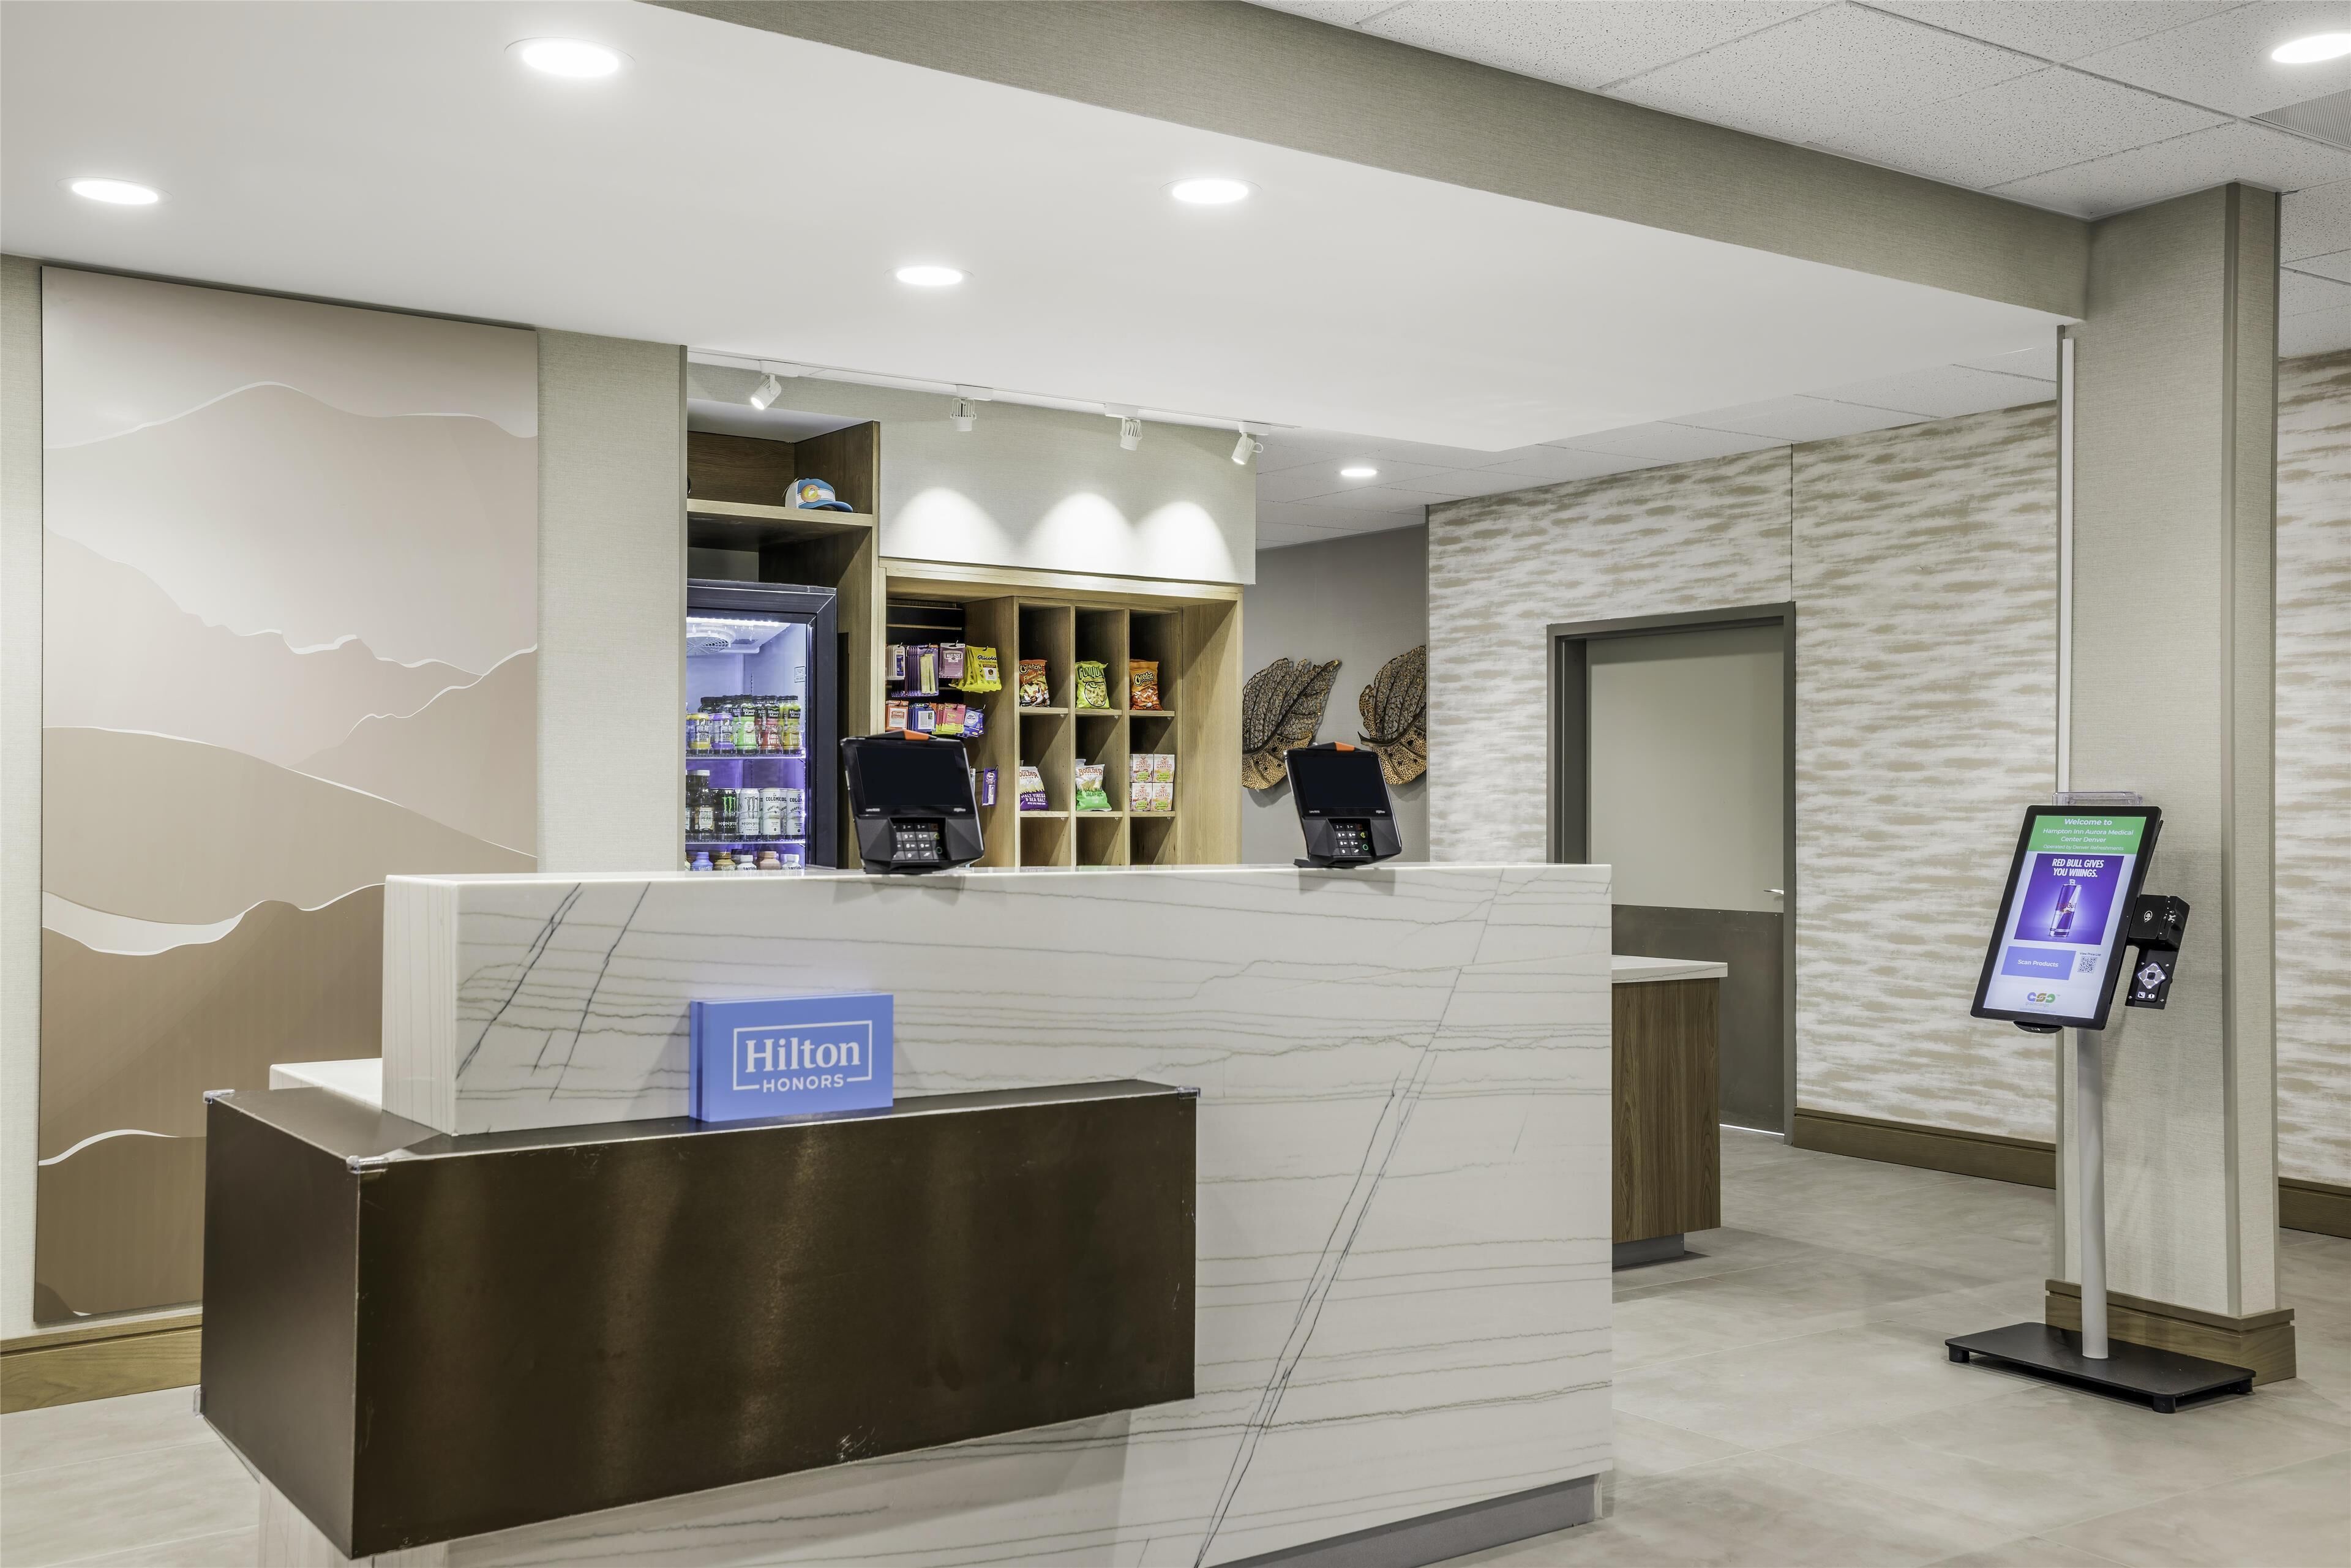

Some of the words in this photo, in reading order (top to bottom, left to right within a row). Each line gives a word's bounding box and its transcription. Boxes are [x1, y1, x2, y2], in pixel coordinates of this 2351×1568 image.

[1019, 664, 1043, 674] Cheetos
[1134, 671, 1155, 686] Cheetos
[2052, 858, 2065, 867] RED
[745, 1037, 861, 1073] Hilton
[763, 1074, 844, 1092] HONORS
